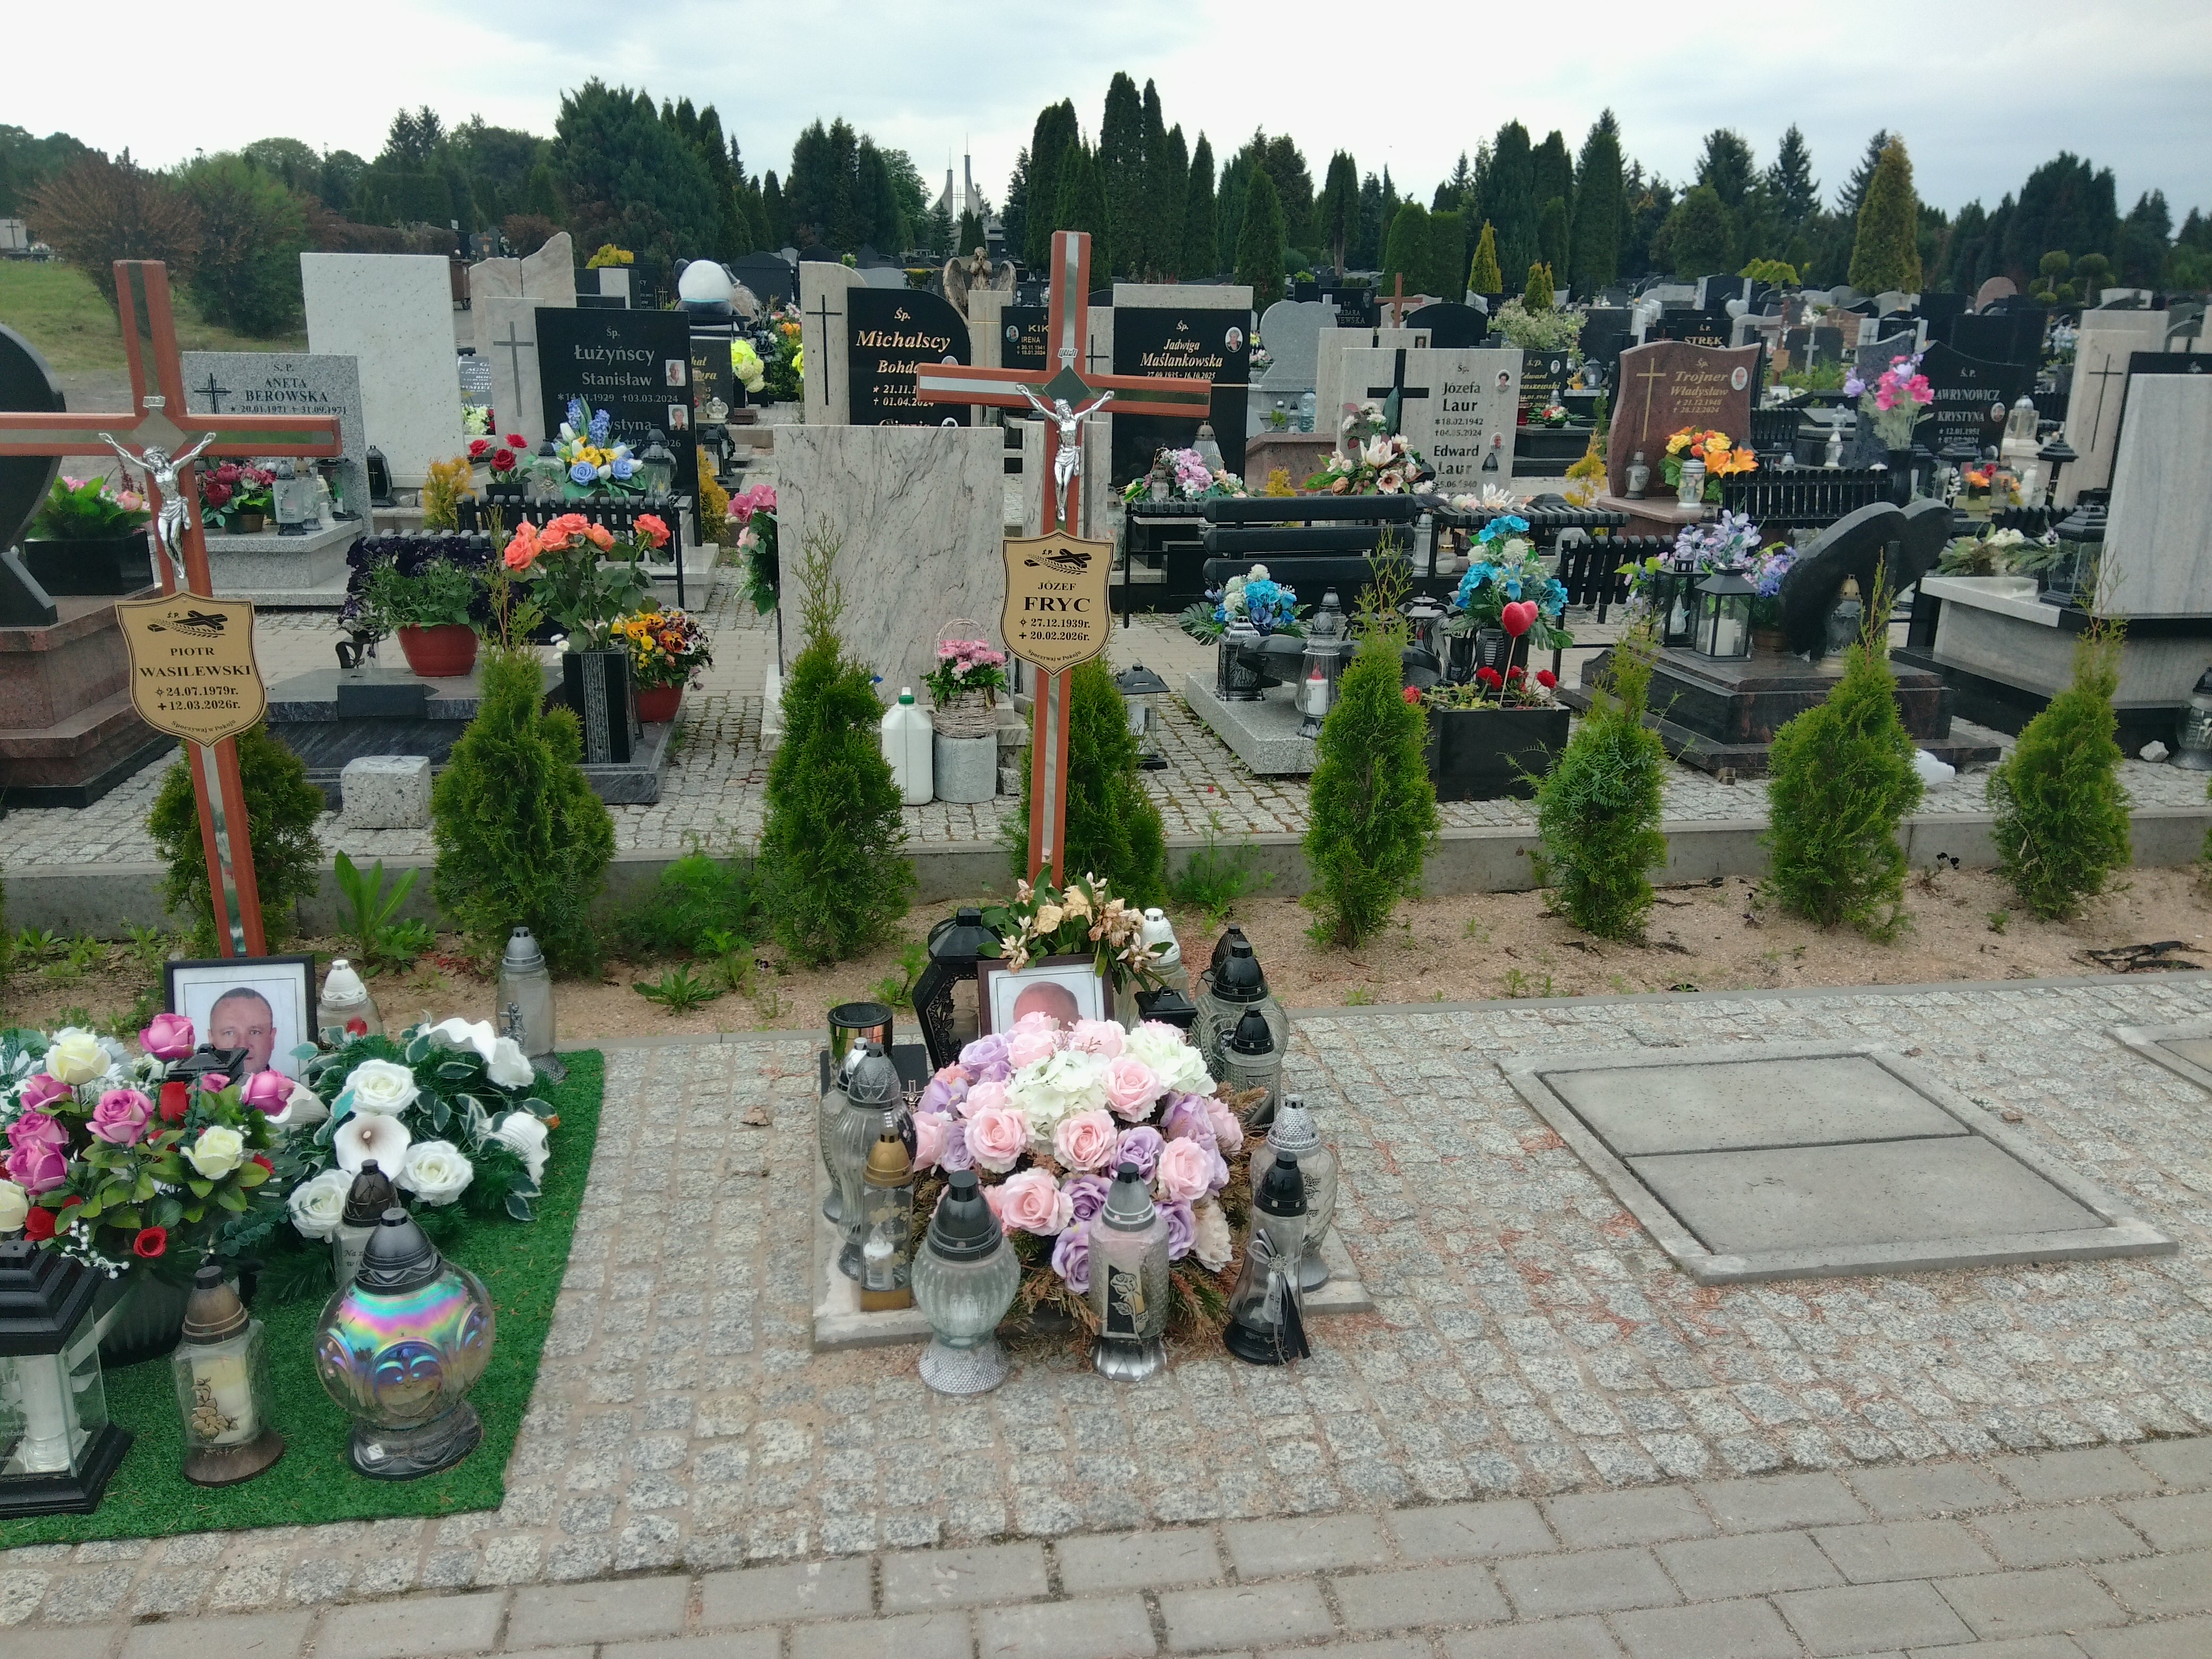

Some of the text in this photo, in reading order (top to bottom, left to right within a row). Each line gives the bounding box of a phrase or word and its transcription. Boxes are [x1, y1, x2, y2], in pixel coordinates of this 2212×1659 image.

[894, 307, 911, 321] Śp.
[1028, 324, 1049, 333] KIK
[1176, 320, 1189, 331] Śp.
[606, 325, 621, 339] Śp.
[856, 330, 951, 353] Michalscy
[1163, 339, 1201, 353] Jadwiga
[574, 345, 655, 366] Łużyńscy
[1139, 352, 1224, 367] Maślankowska
[265, 378, 307, 389] ANETA
[582, 372, 652, 387] Stanisław
[1675, 371, 1728, 384] Trojner
[883, 384, 917, 394] 21.11.1
[1443, 381, 1481, 396] Józefa
[1670, 386, 1729, 398] Władysław
[246, 390, 329, 403] BEROWSKA
[1443, 399, 1478, 412] Laur
[1937, 410, 1985, 422] KRYSTYNA
[1434, 445, 1480, 457] Edward
[1438, 461, 1472, 475] Laur
[1038, 581, 1076, 591] JÓZEF
[1024, 597, 1090, 612] FRYC
[1030, 618, 1091, 628] 27.12.1939r.
[1030, 631, 1090, 641] 20.02.2026r.
[170, 647, 215, 656] PIOTR
[1027, 649, 1056, 661] Spoczywaj
[1062, 650, 1082, 660] Pokoju
[139, 665, 251, 677] WASILEWSKI
[166, 685, 239, 697] 24.07.1979r.
[169, 699, 241, 710] 12.03.2026r.
[171, 720, 207, 733] Spoczywaj
[215, 718, 236, 731] Pokoju
